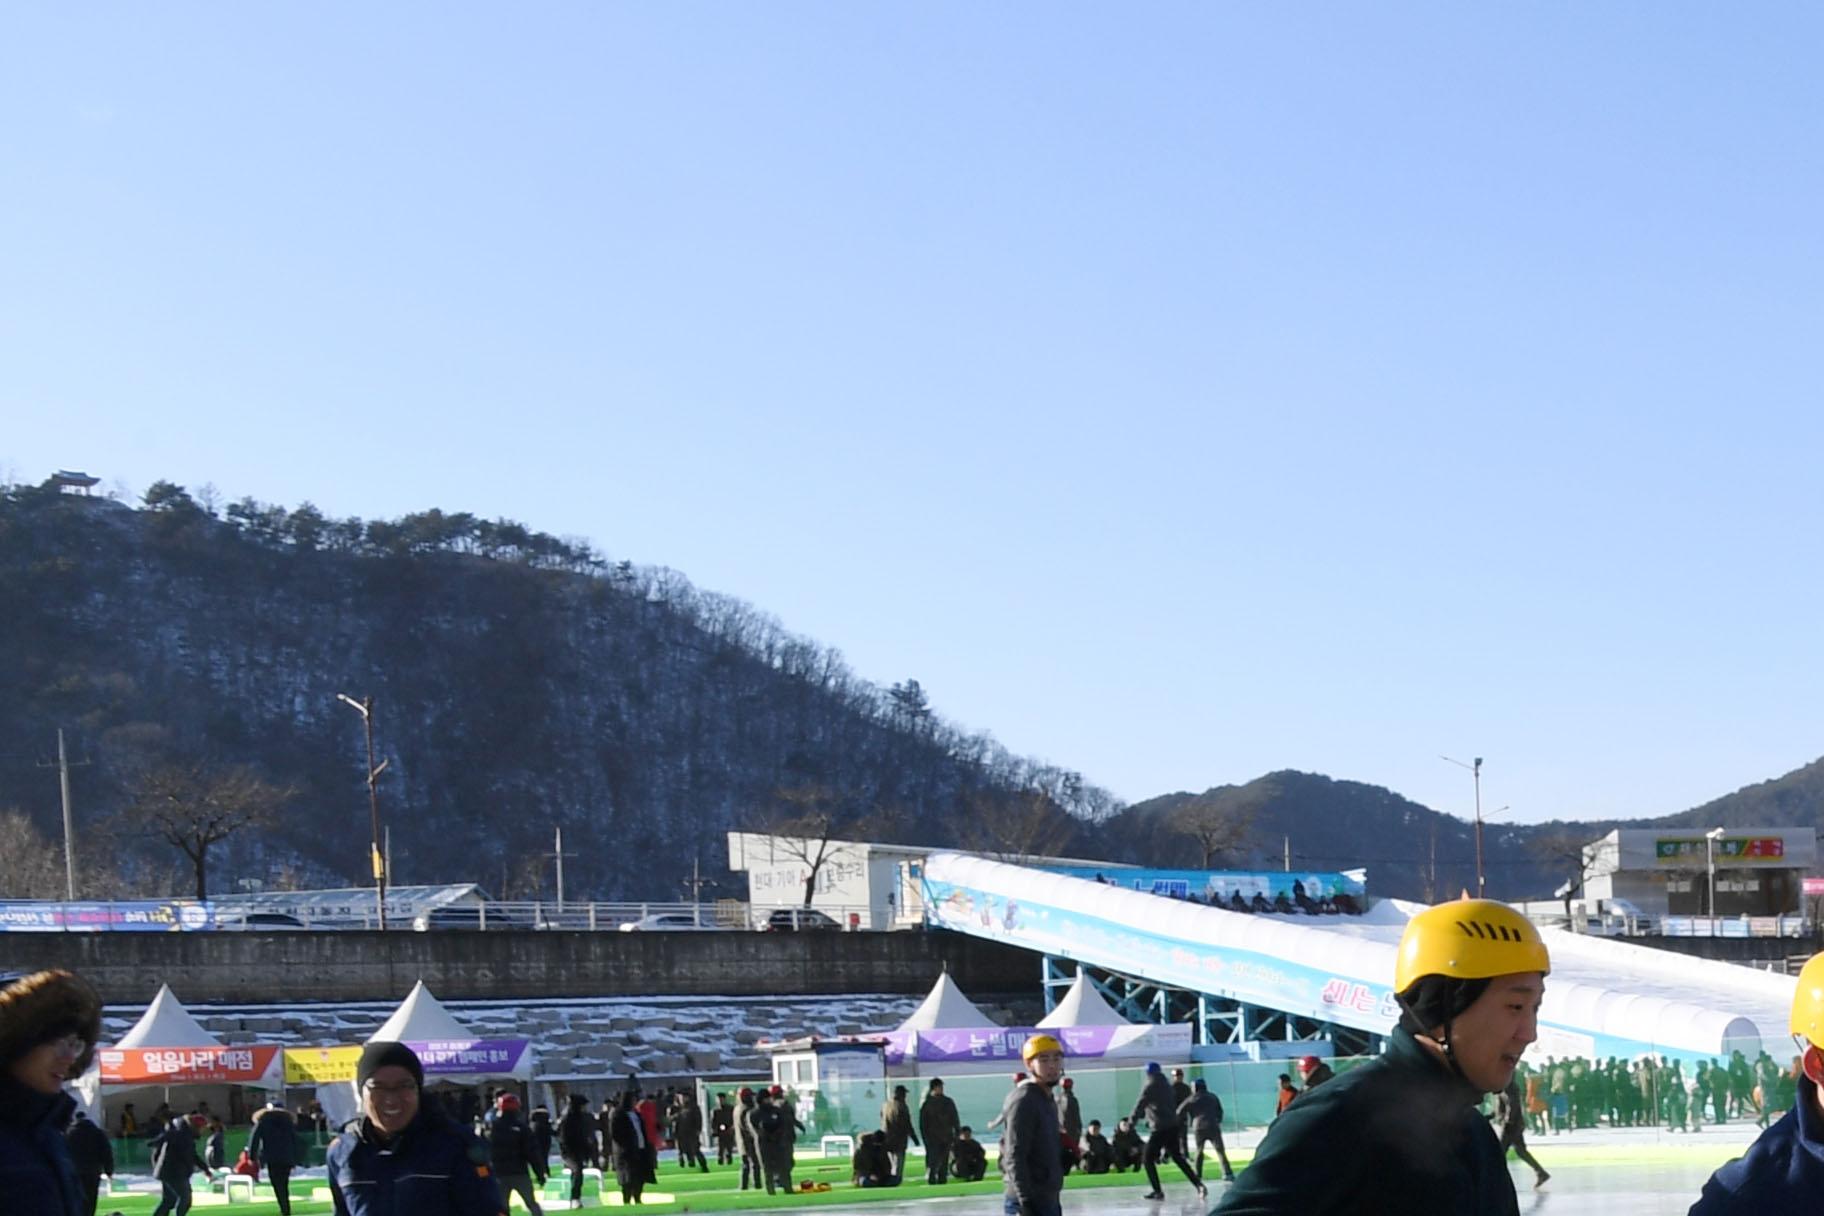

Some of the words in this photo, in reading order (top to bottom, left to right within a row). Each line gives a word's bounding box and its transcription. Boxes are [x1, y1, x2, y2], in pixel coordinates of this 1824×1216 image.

[968, 1033, 1037, 1057] 눈썰매
[143, 1050, 215, 1073] 얼음나라
[218, 1049, 254, 1070] 매점
